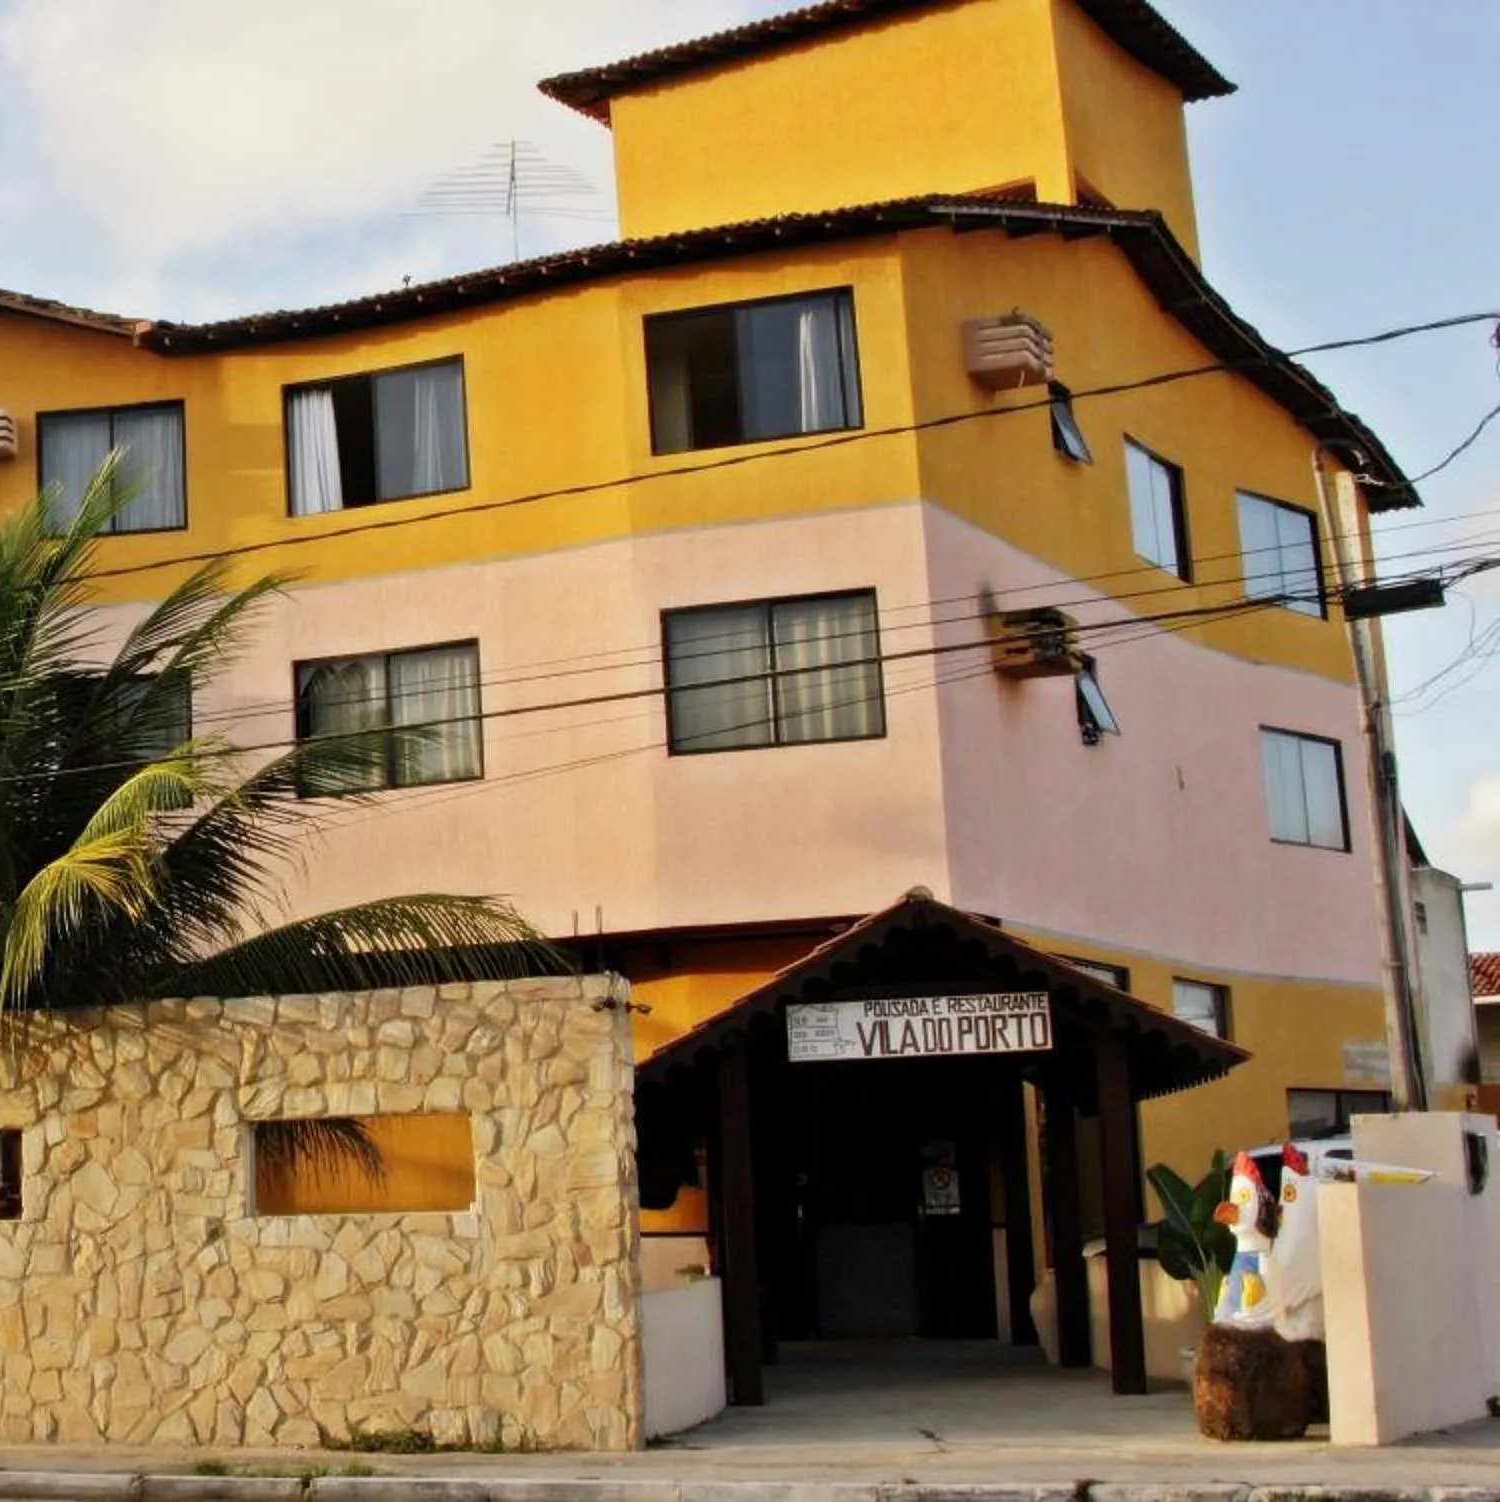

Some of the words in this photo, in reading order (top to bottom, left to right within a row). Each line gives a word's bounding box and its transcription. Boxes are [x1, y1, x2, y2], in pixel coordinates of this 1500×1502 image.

[863, 999, 928, 1017] POUSADA
[932, 998, 943, 1015] E
[958, 1012, 1048, 1051] PORTO
